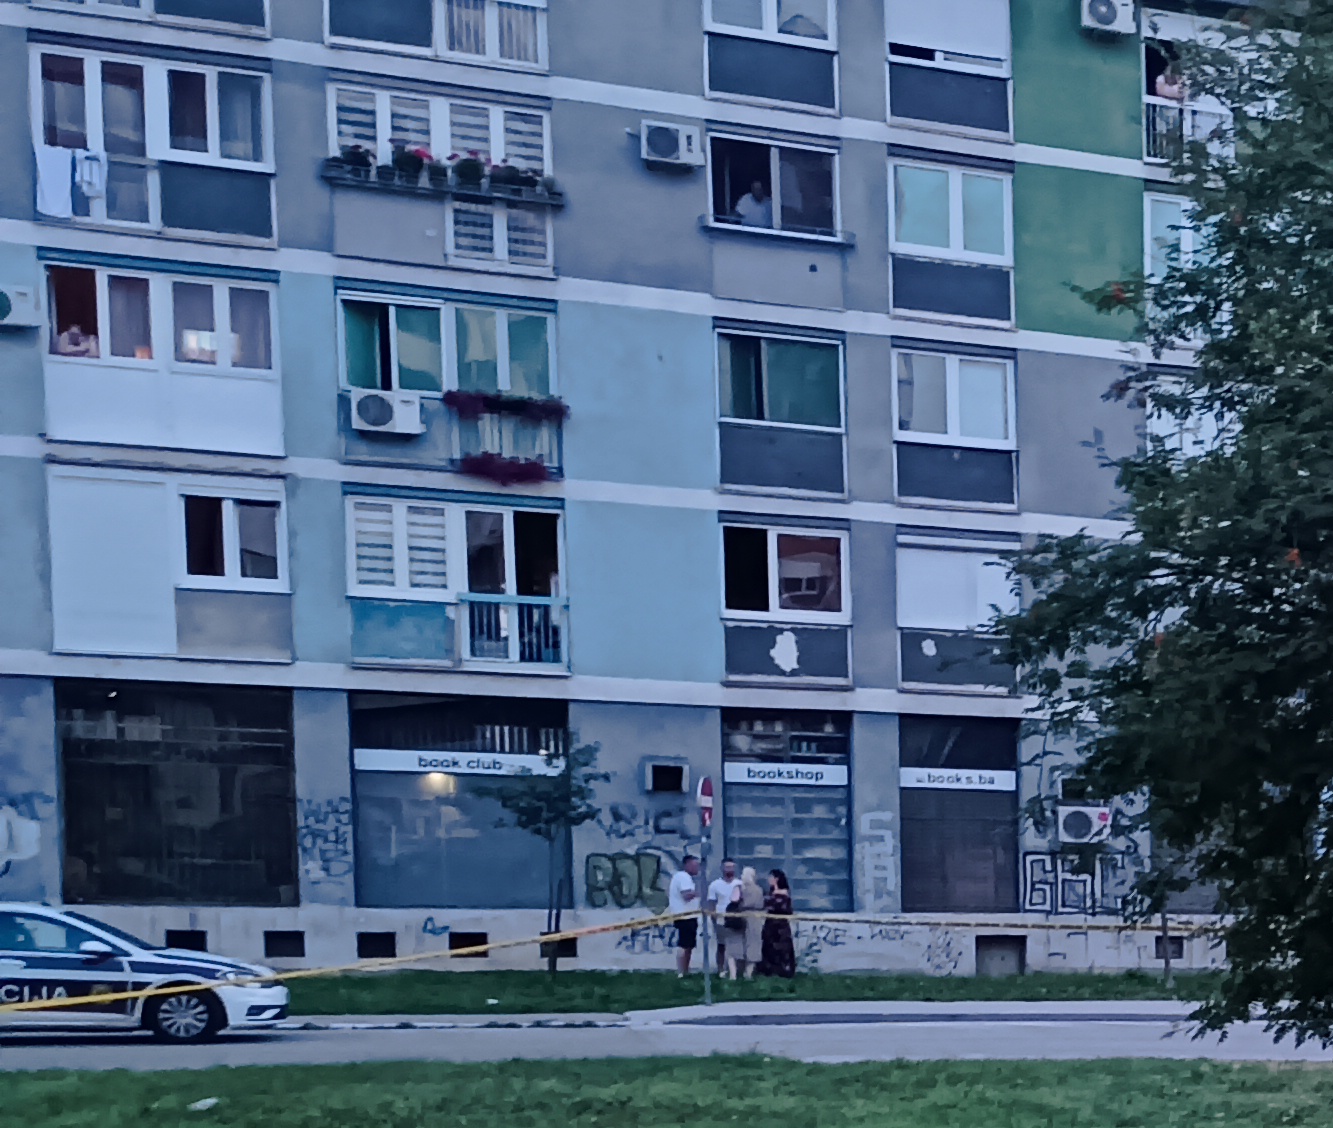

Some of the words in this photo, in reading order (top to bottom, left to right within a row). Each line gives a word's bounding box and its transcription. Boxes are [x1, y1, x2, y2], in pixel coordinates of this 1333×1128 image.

[418, 756, 461, 769] book
[466, 757, 503, 770] club
[747, 767, 825, 782] bookshop
